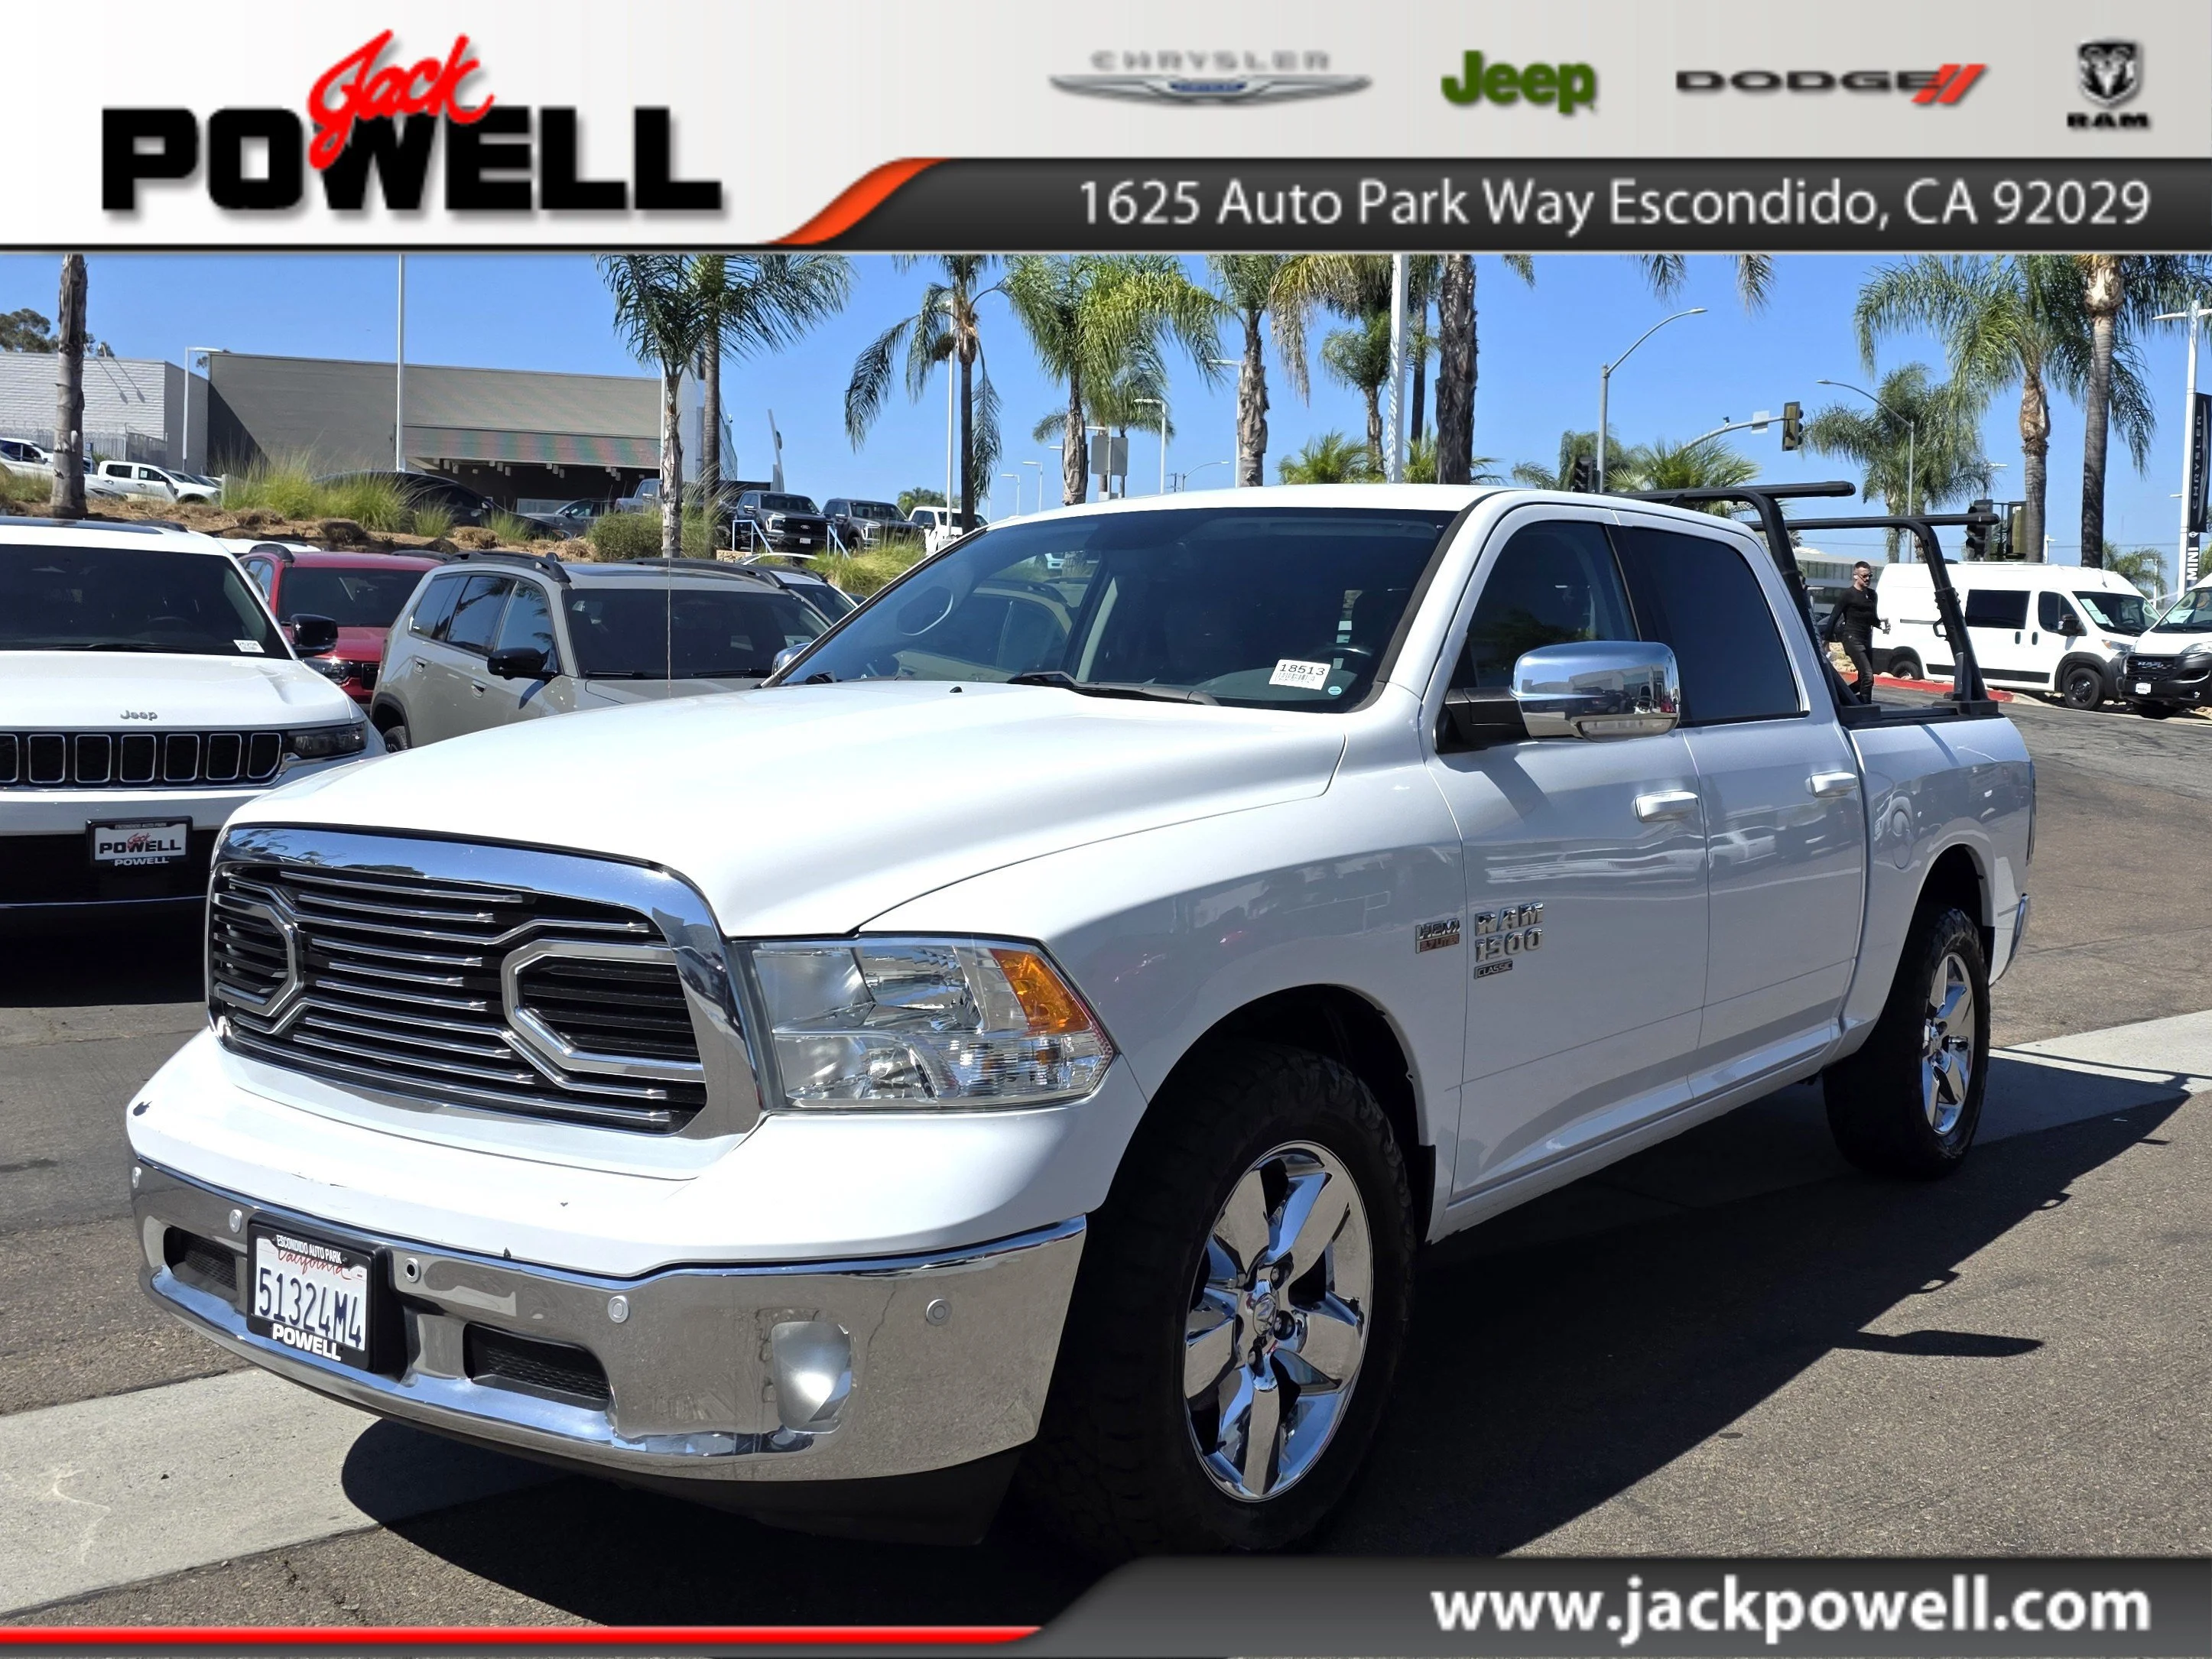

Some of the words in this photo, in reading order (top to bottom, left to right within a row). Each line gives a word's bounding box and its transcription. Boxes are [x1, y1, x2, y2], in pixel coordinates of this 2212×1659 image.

[2191, 414, 2202, 510] CHRYSLER
[2187, 547, 2199, 581] MINI
[1279, 663, 1326, 676] 18513
[120, 709, 158, 721] Jeep
[99, 839, 182, 854] POWELL
[114, 856, 170, 866] POWELL
[1417, 918, 1460, 940] HEMI
[1475, 901, 1544, 937] RAM
[1475, 927, 1543, 963] 1500
[1477, 960, 1513, 978] CLASSIC
[276, 1234, 308, 1255] ESCONDIDO
[308, 1243, 325, 1259] AUTO
[325, 1248, 343, 1265] PARK
[258, 1267, 362, 1348] 51324M4
[272, 1323, 342, 1362] POWELL
